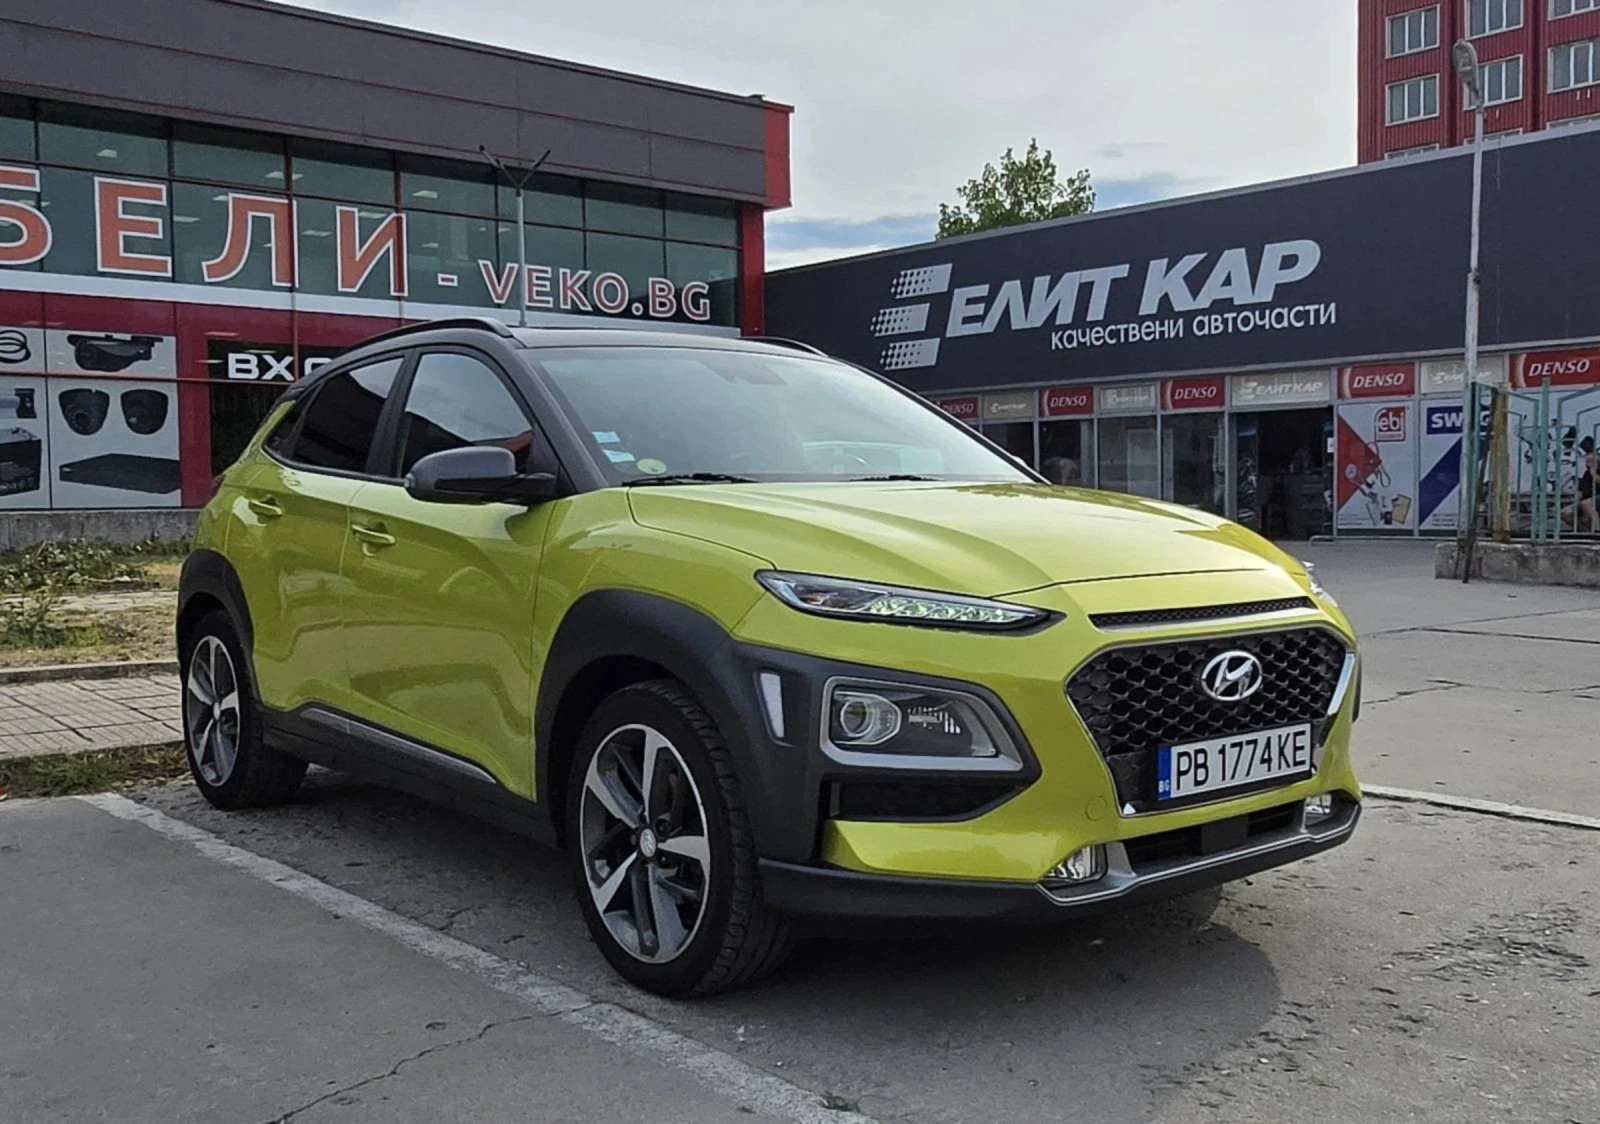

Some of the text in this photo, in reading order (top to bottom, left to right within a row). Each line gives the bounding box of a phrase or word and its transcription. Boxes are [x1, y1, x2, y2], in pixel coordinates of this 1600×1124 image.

[945, 238, 1322, 338] ЕЛИТ КАР
[1051, 302, 1337, 350] качествени авточасти
[227, 352, 334, 381] ВХ
[1528, 358, 1591, 377] DENSO
[1352, 373, 1405, 389] DENSO
[1050, 394, 1087, 408] DENSO
[1174, 386, 1217, 400] DENSO
[943, 402, 974, 415] DENSO
[1431, 411, 1491, 428] SWG
[1217, 735, 1273, 782] 1774
